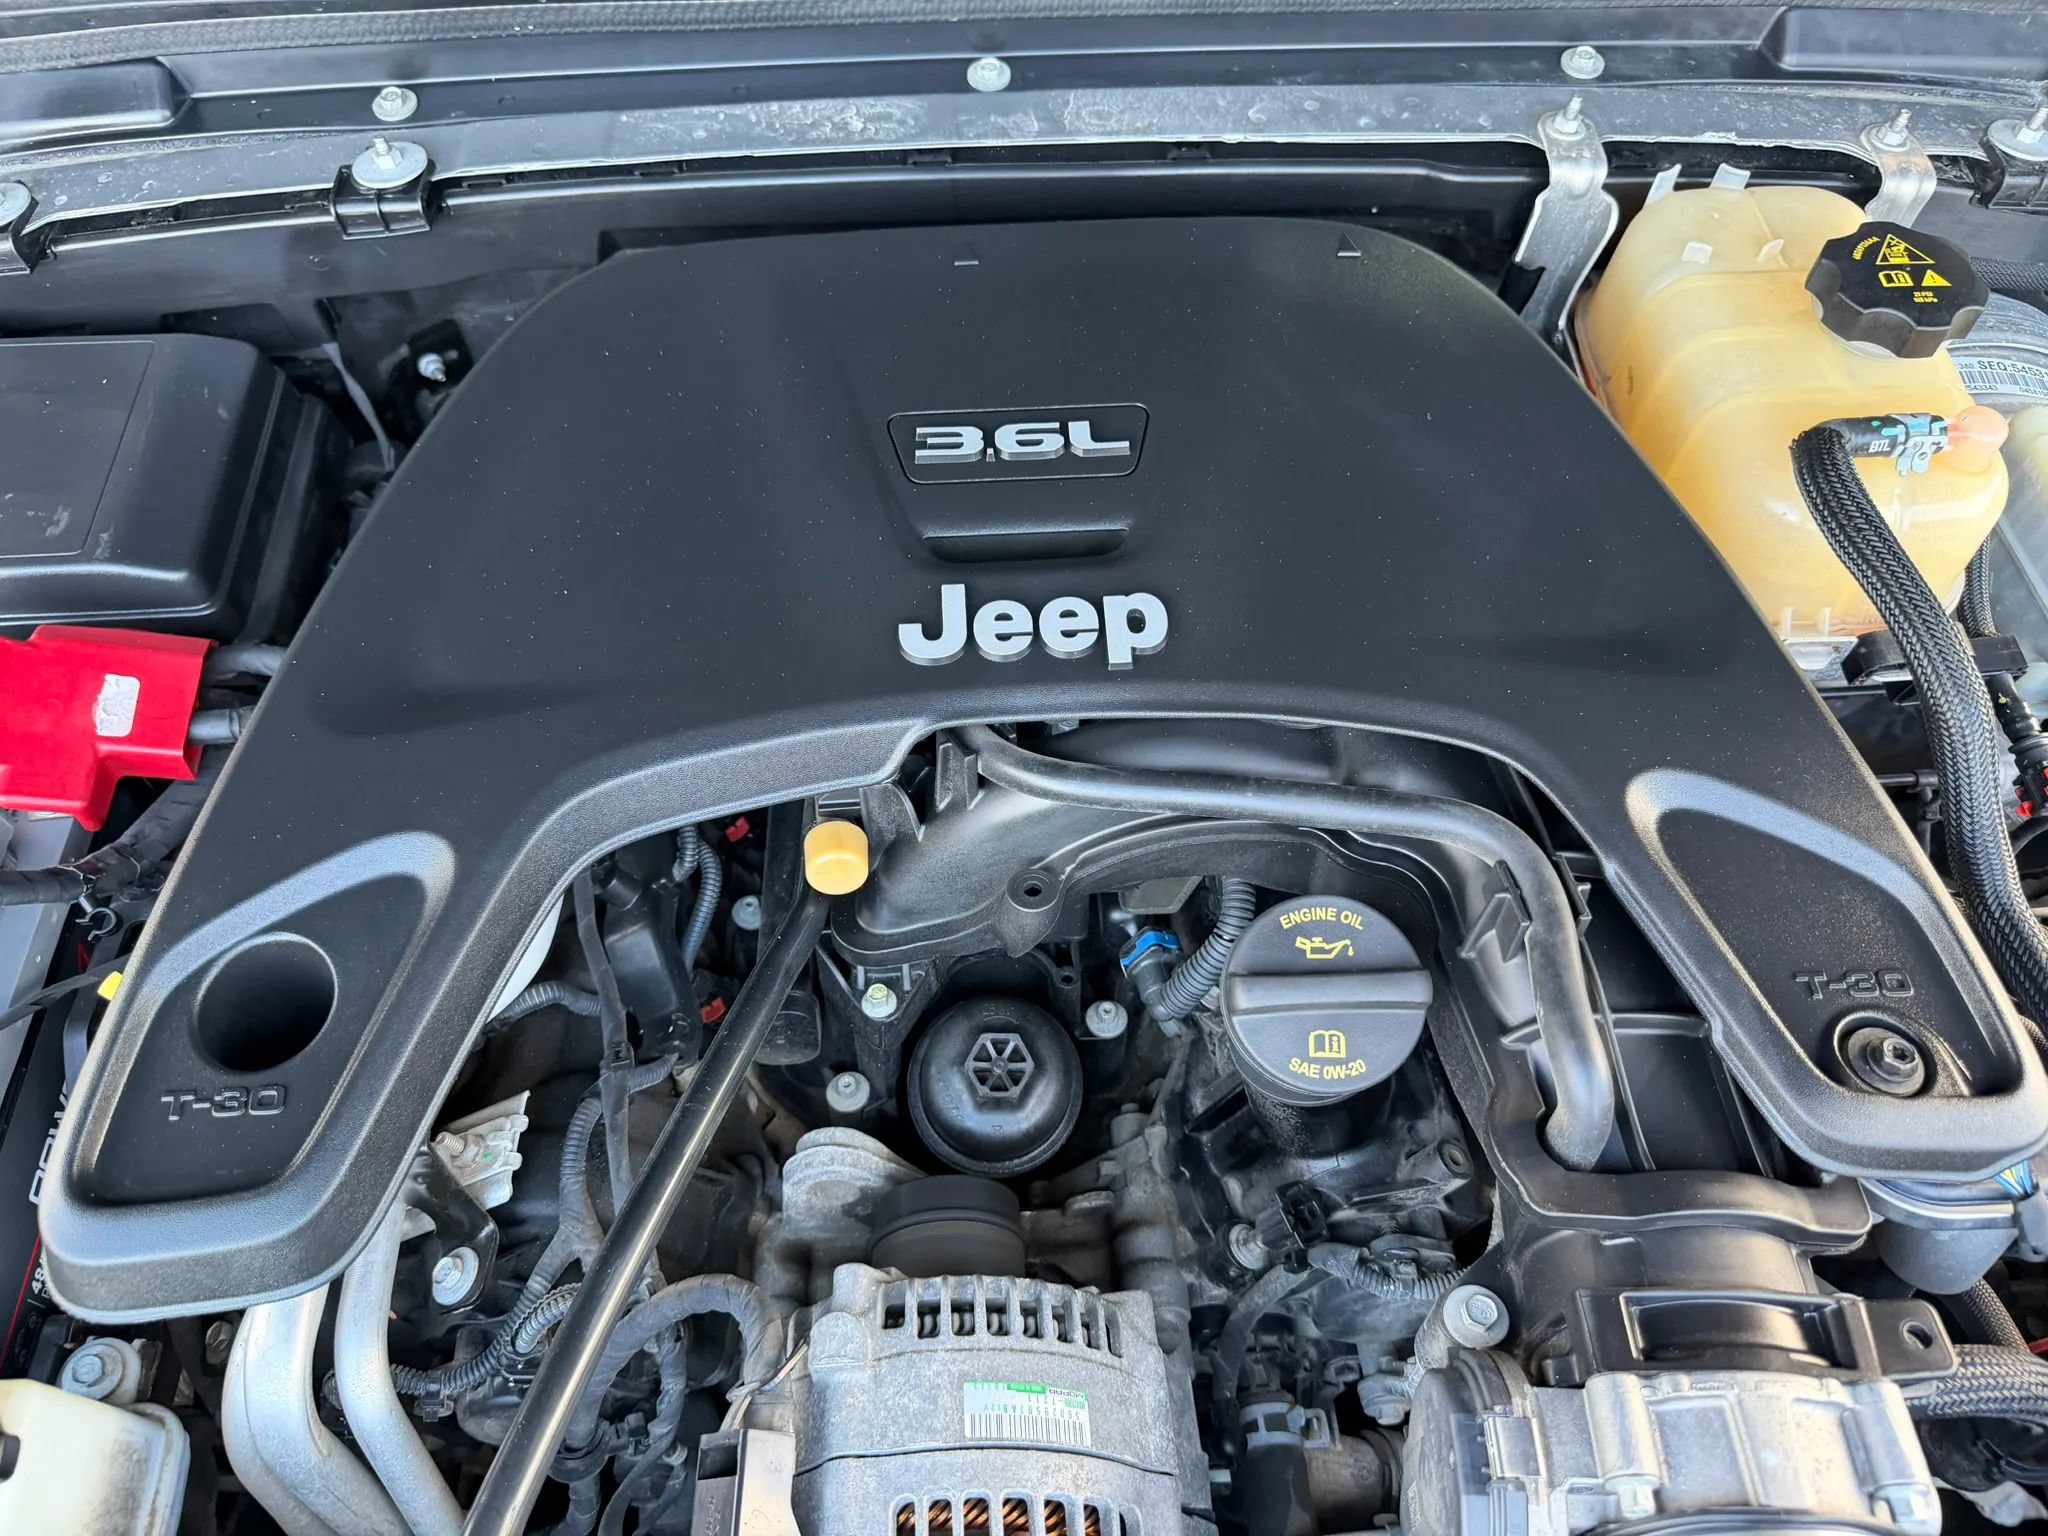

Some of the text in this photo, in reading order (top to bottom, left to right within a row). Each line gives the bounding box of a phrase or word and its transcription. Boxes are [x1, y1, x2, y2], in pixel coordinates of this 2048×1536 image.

[914, 420, 1131, 465] 3.6L
[898, 583, 1169, 670] Jeep
[1279, 907, 1364, 931] ENGINE OIL
[1794, 970, 1914, 1000] T-30
[1289, 1057, 1367, 1080] SAE 0W-20
[161, 1084, 291, 1121] T-30
